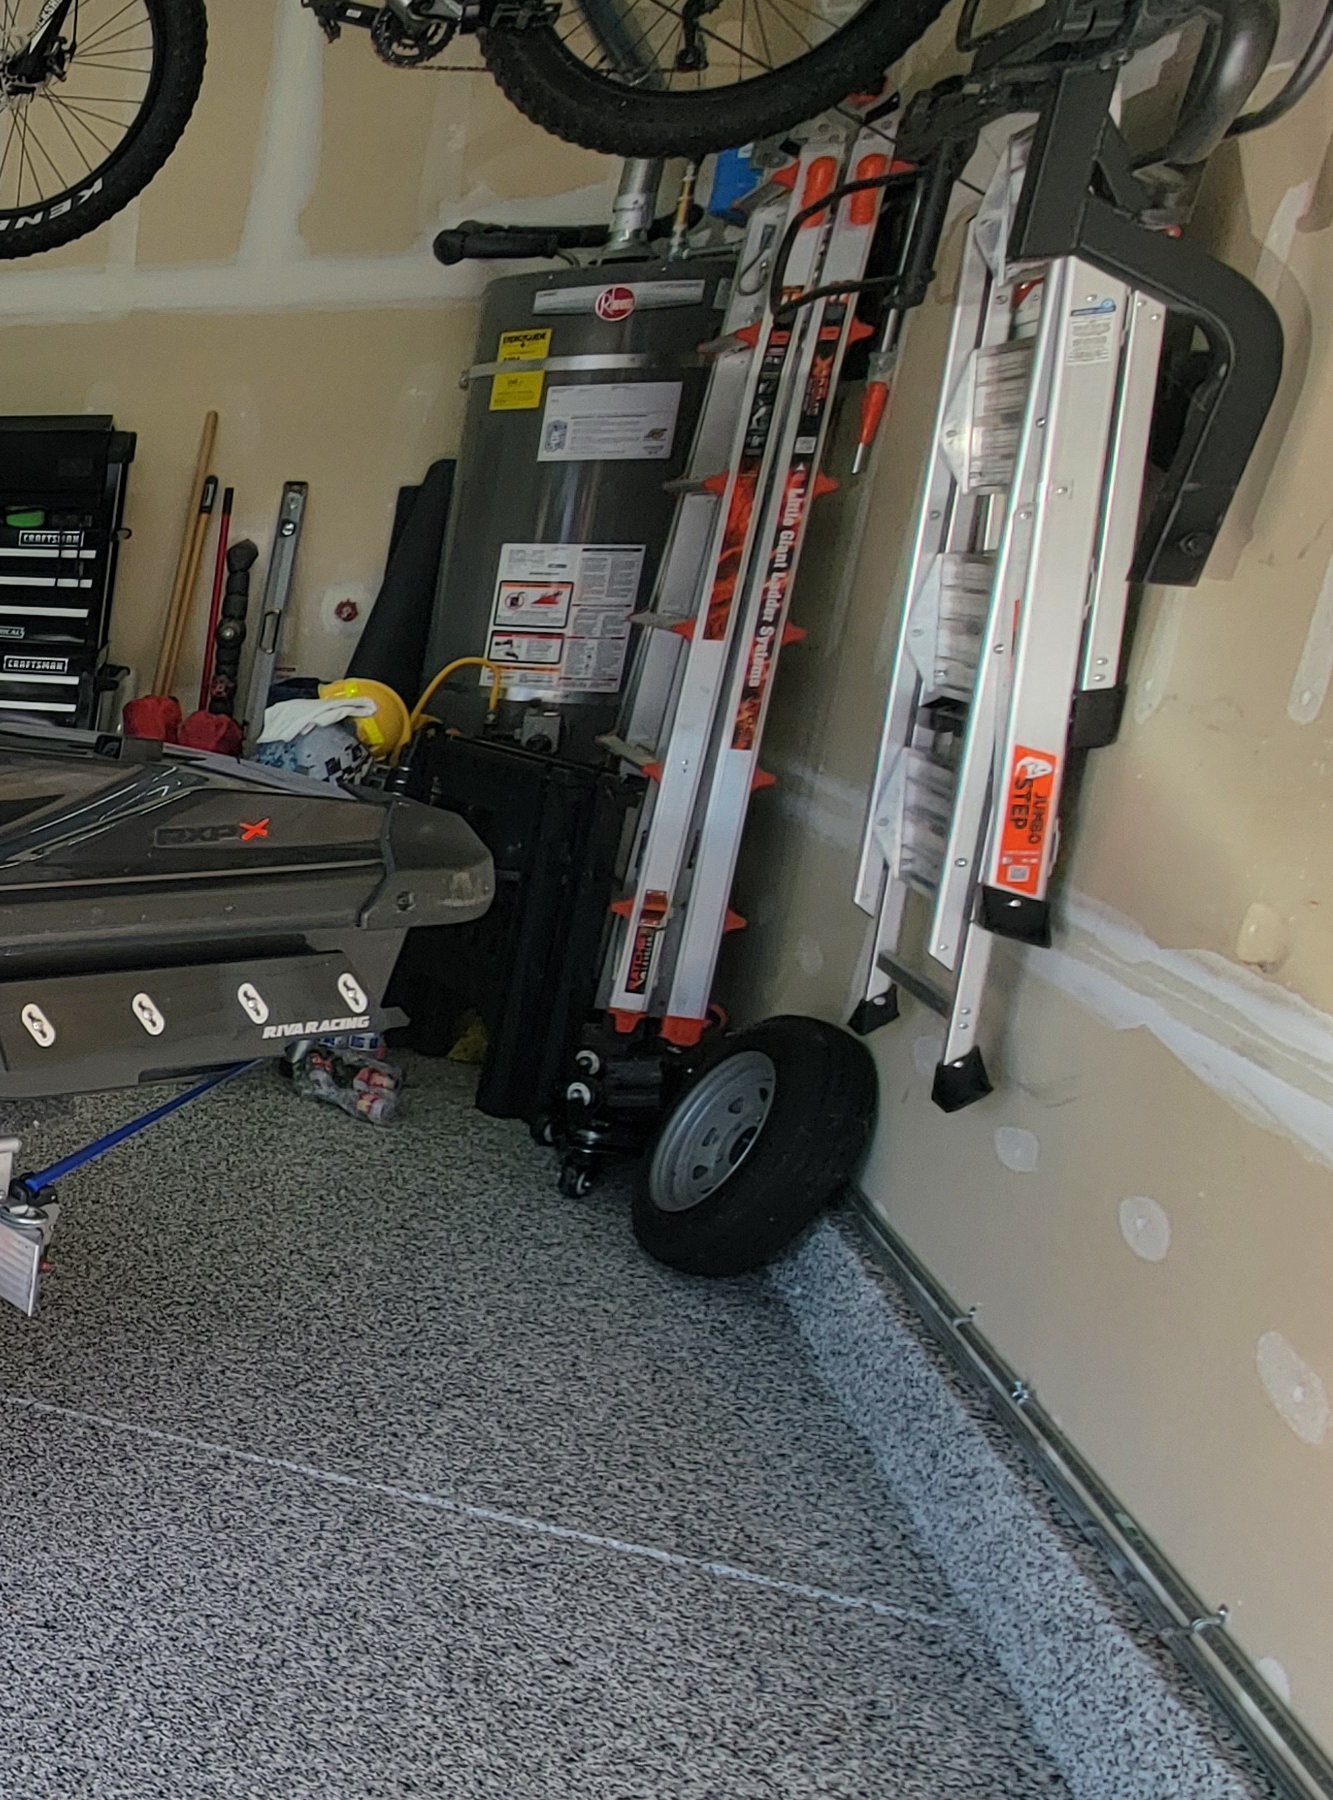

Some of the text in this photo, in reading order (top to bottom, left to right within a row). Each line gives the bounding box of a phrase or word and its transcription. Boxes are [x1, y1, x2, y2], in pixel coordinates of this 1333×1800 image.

[748, 487, 805, 688] Little Giant Ladder Systems
[8, 659, 64, 670] CRAFTSMAN
[1011, 777, 1032, 829] STEP
[1028, 793, 1048, 844] JUMBO
[262, 1016, 370, 1039] RIVA RACING
